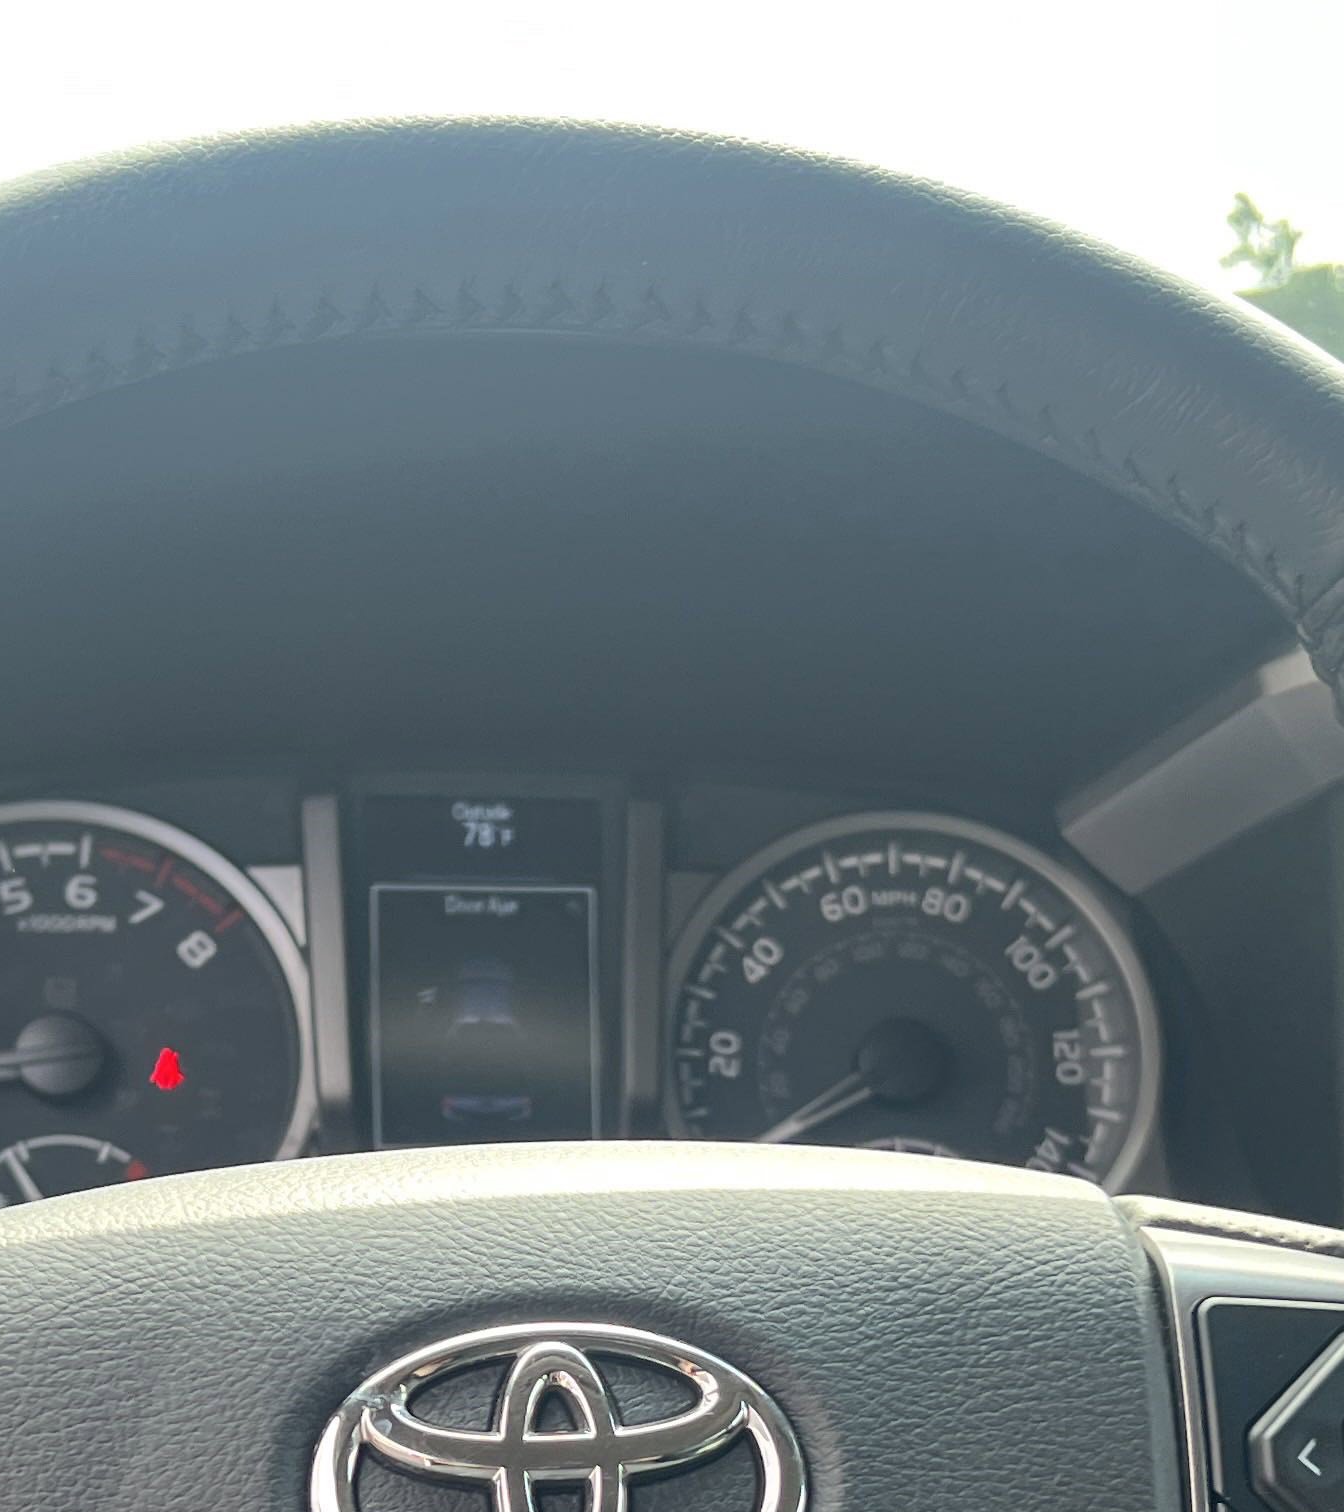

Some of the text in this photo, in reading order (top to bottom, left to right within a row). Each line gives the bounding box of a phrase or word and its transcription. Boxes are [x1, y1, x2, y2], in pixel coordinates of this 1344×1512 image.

[64, 874, 99, 909] 6
[128, 889, 165, 925] 7
[819, 885, 868, 923] 60
[870, 889, 917, 908] MPH
[920, 886, 972, 923] 80
[176, 930, 218, 969] 8
[742, 937, 785, 984] 40
[1004, 934, 1058, 990] 100
[708, 1030, 742, 1078] 20
[1053, 1029, 1084, 1085] 120
